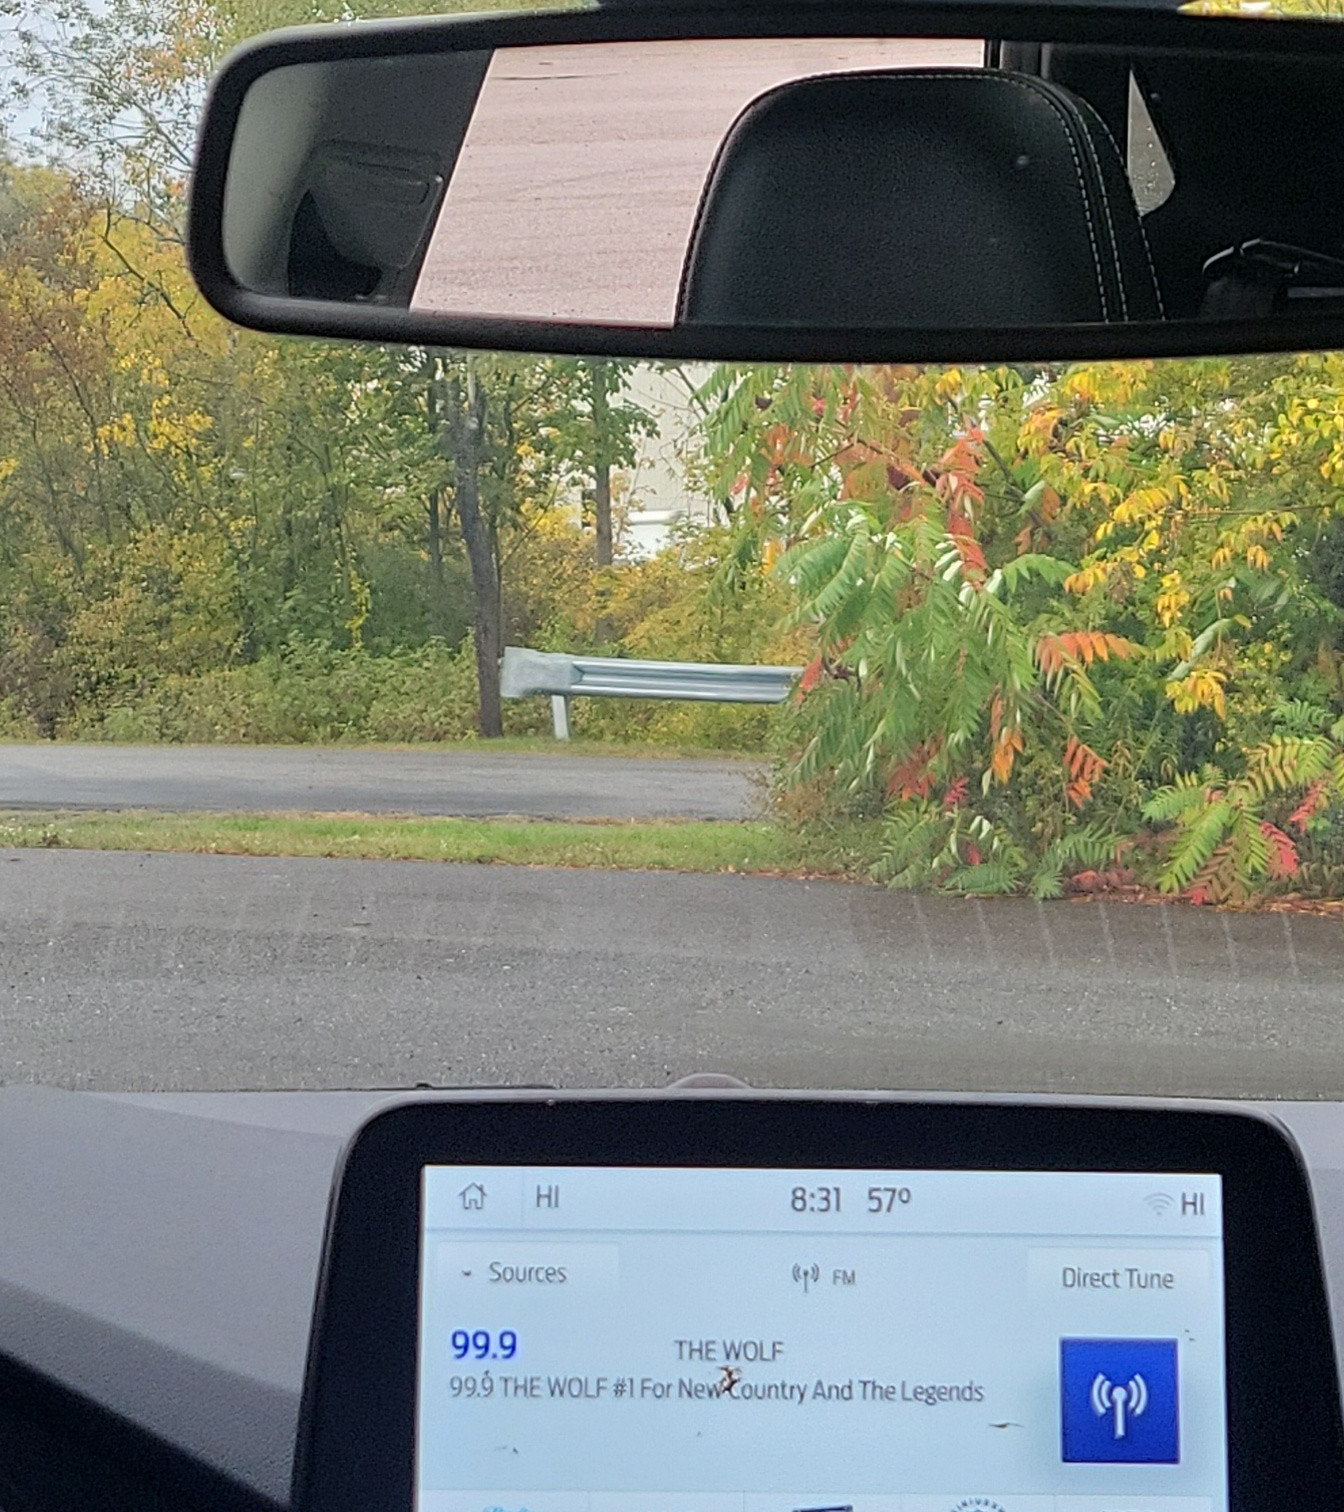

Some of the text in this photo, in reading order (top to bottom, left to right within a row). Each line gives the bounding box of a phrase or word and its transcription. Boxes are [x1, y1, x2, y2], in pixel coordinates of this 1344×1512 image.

[536, 1184, 559, 1209] HI
[790, 1186, 842, 1213] 8:31
[1181, 1191, 1205, 1216] HI
[488, 1261, 568, 1284] Sources
[832, 1270, 856, 1286] FM
[1062, 1266, 1175, 1289] Direct Tune
[451, 1329, 518, 1360] 99.9
[674, 1340, 784, 1362] THE WOLF
[450, 1375, 985, 1406] 99.9 THE WOLF #1 For New Country And The Legends
